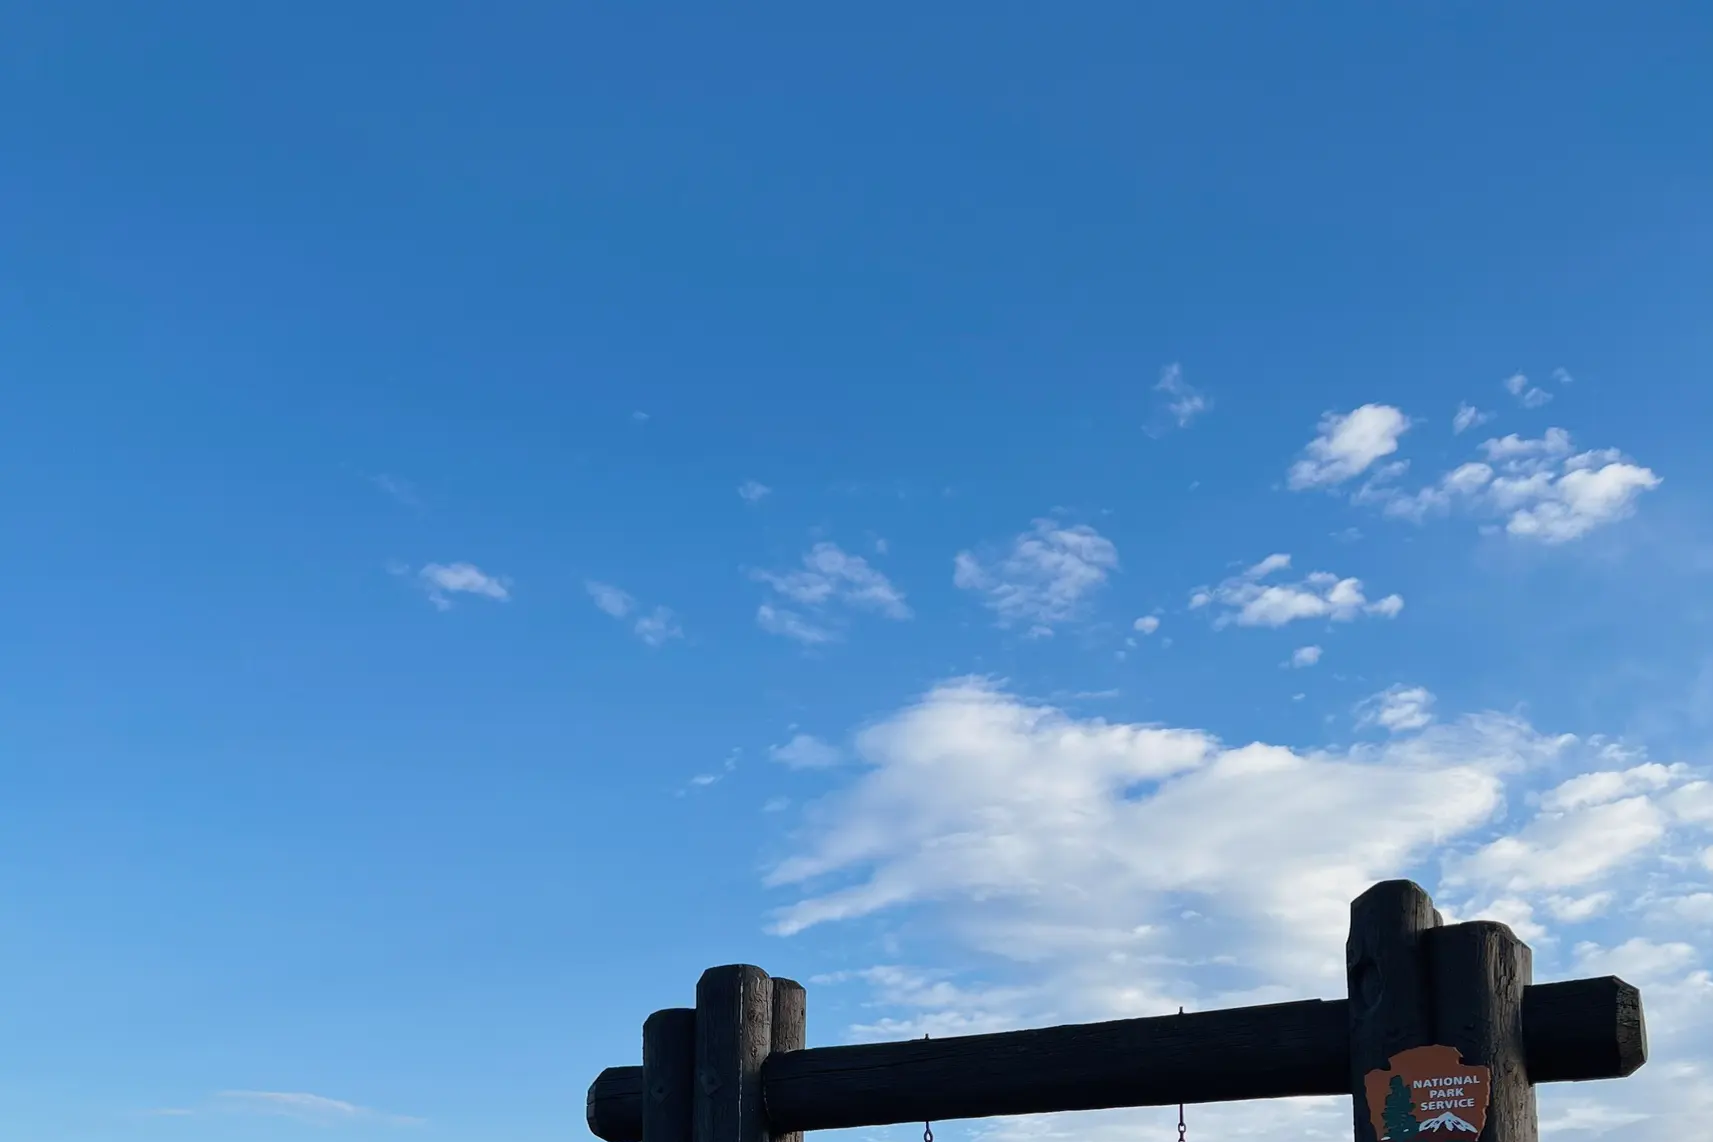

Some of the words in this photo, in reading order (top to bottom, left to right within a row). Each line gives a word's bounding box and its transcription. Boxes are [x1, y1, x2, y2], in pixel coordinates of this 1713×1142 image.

[1413, 1075, 1480, 1088] NATIONAL
[1429, 1088, 1464, 1099] PARK
[1420, 1098, 1475, 1111] SERVICE
